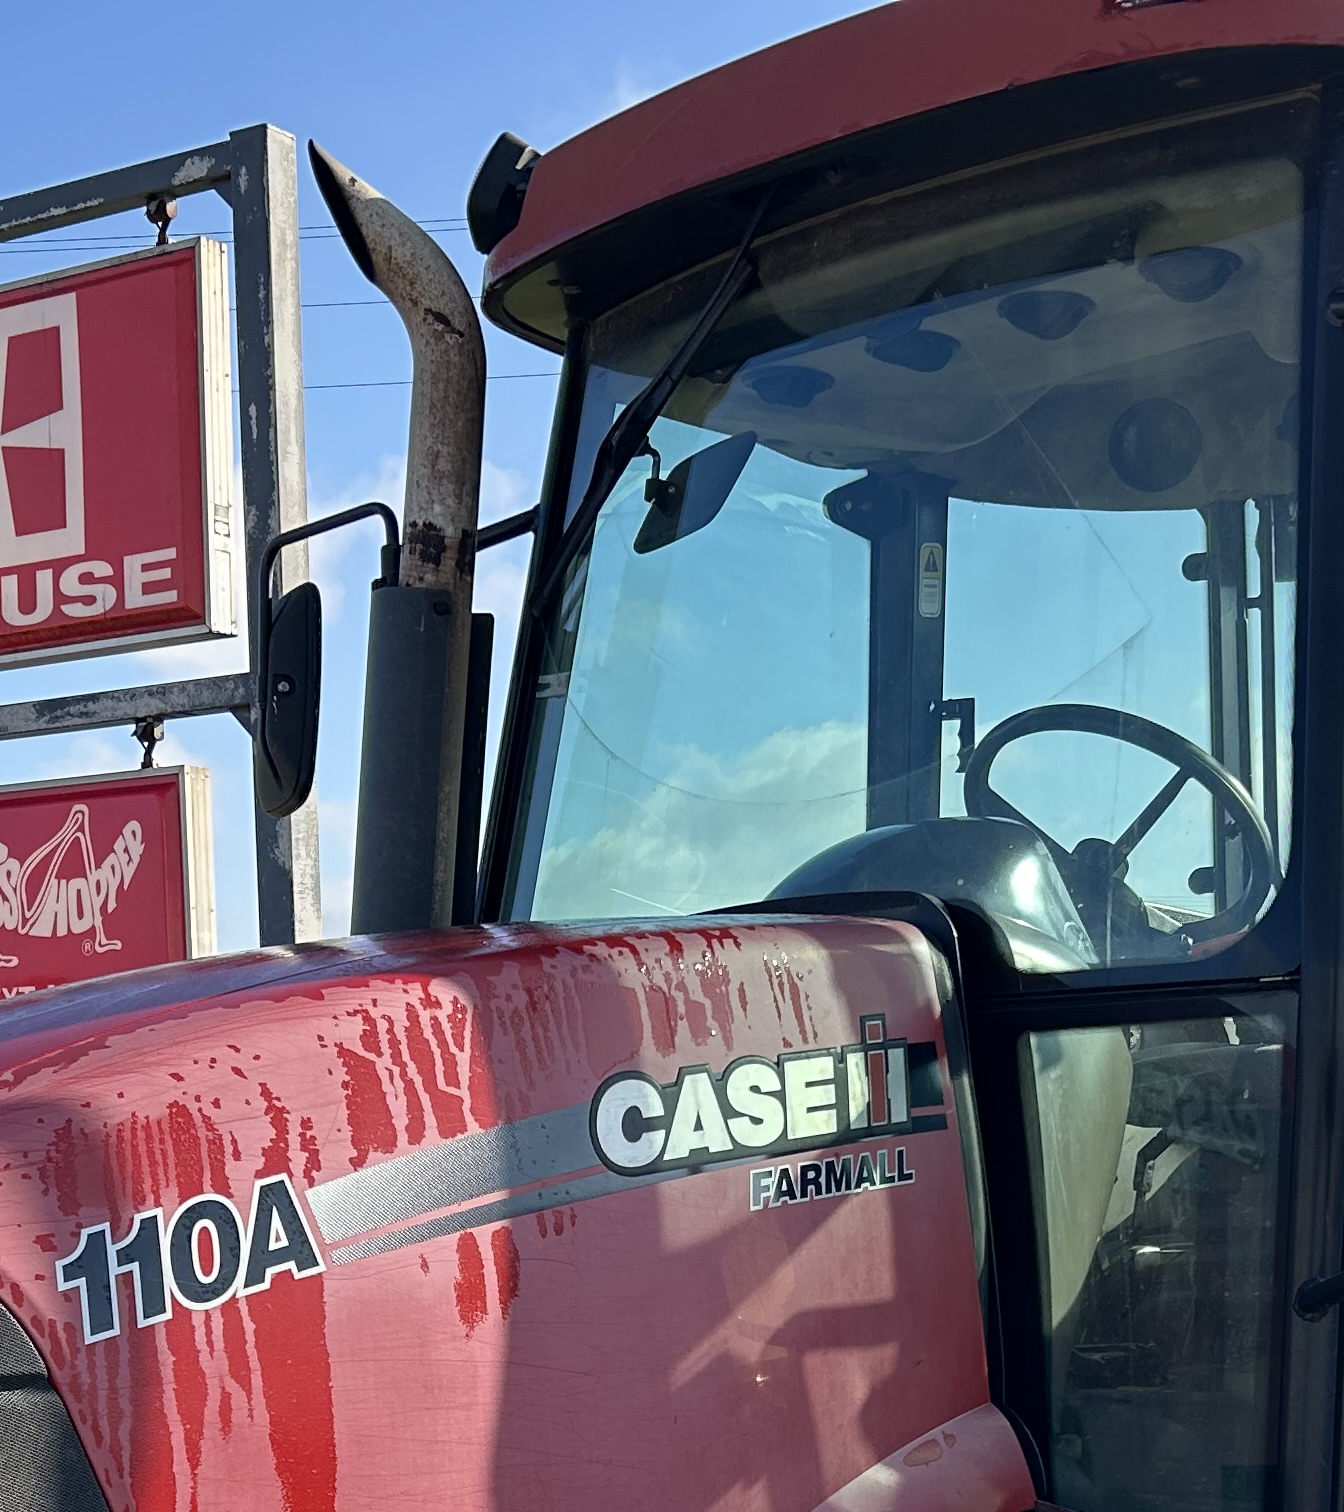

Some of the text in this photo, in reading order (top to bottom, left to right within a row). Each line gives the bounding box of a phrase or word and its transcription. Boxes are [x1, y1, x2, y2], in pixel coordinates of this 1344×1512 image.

[593, 1055, 840, 1170] CASE
[748, 1145, 916, 1213] FARMALL
[54, 1172, 328, 1346] 110A
